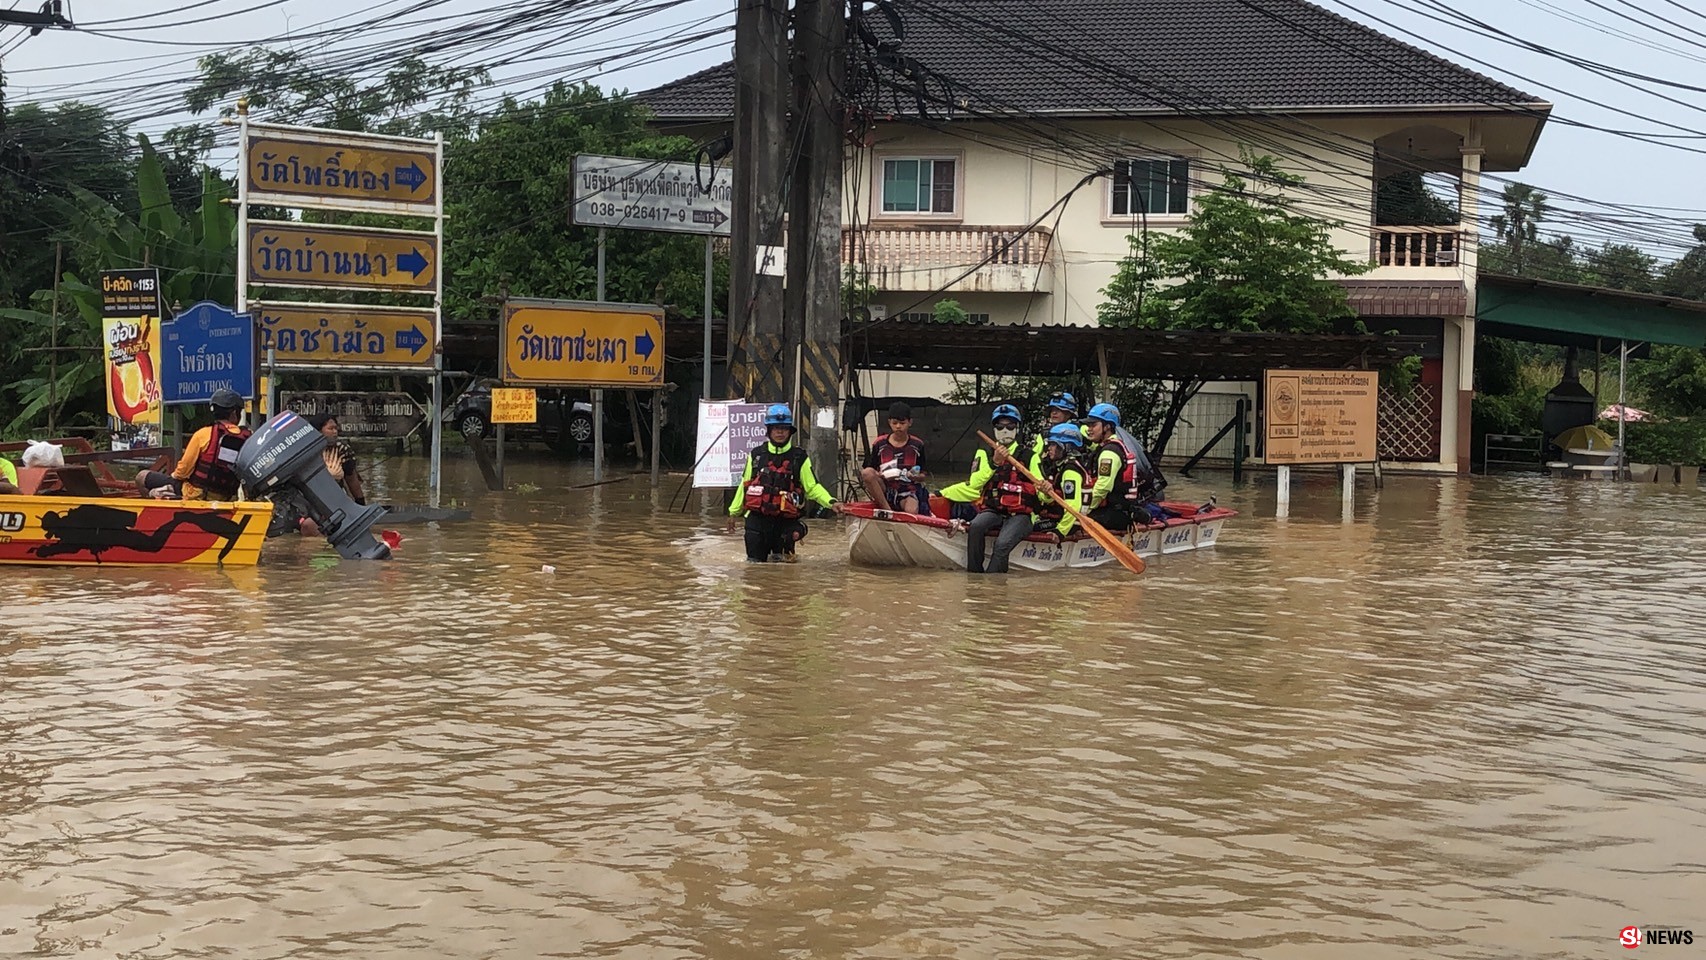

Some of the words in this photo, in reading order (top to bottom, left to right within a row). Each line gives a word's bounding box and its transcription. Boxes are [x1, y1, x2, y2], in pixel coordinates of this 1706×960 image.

[256, 151, 390, 191] วัดโพธิ์ทอง
[582, 168, 616, 192] บริษัท
[590, 201, 686, 223] 038-026417-9
[258, 235, 388, 277] วัดบ้านนา
[138, 278, 155, 291] 1153
[110, 320, 138, 344] ผ่อน
[261, 315, 386, 354] วัดชำฆ้อ
[516, 323, 628, 364] วัดเขาชะเมา
[177, 343, 233, 373] โพธิ์ทอง
[627, 365, 639, 376] 19
[178, 381, 200, 395] PHOO
[203, 379, 233, 393] THONG
